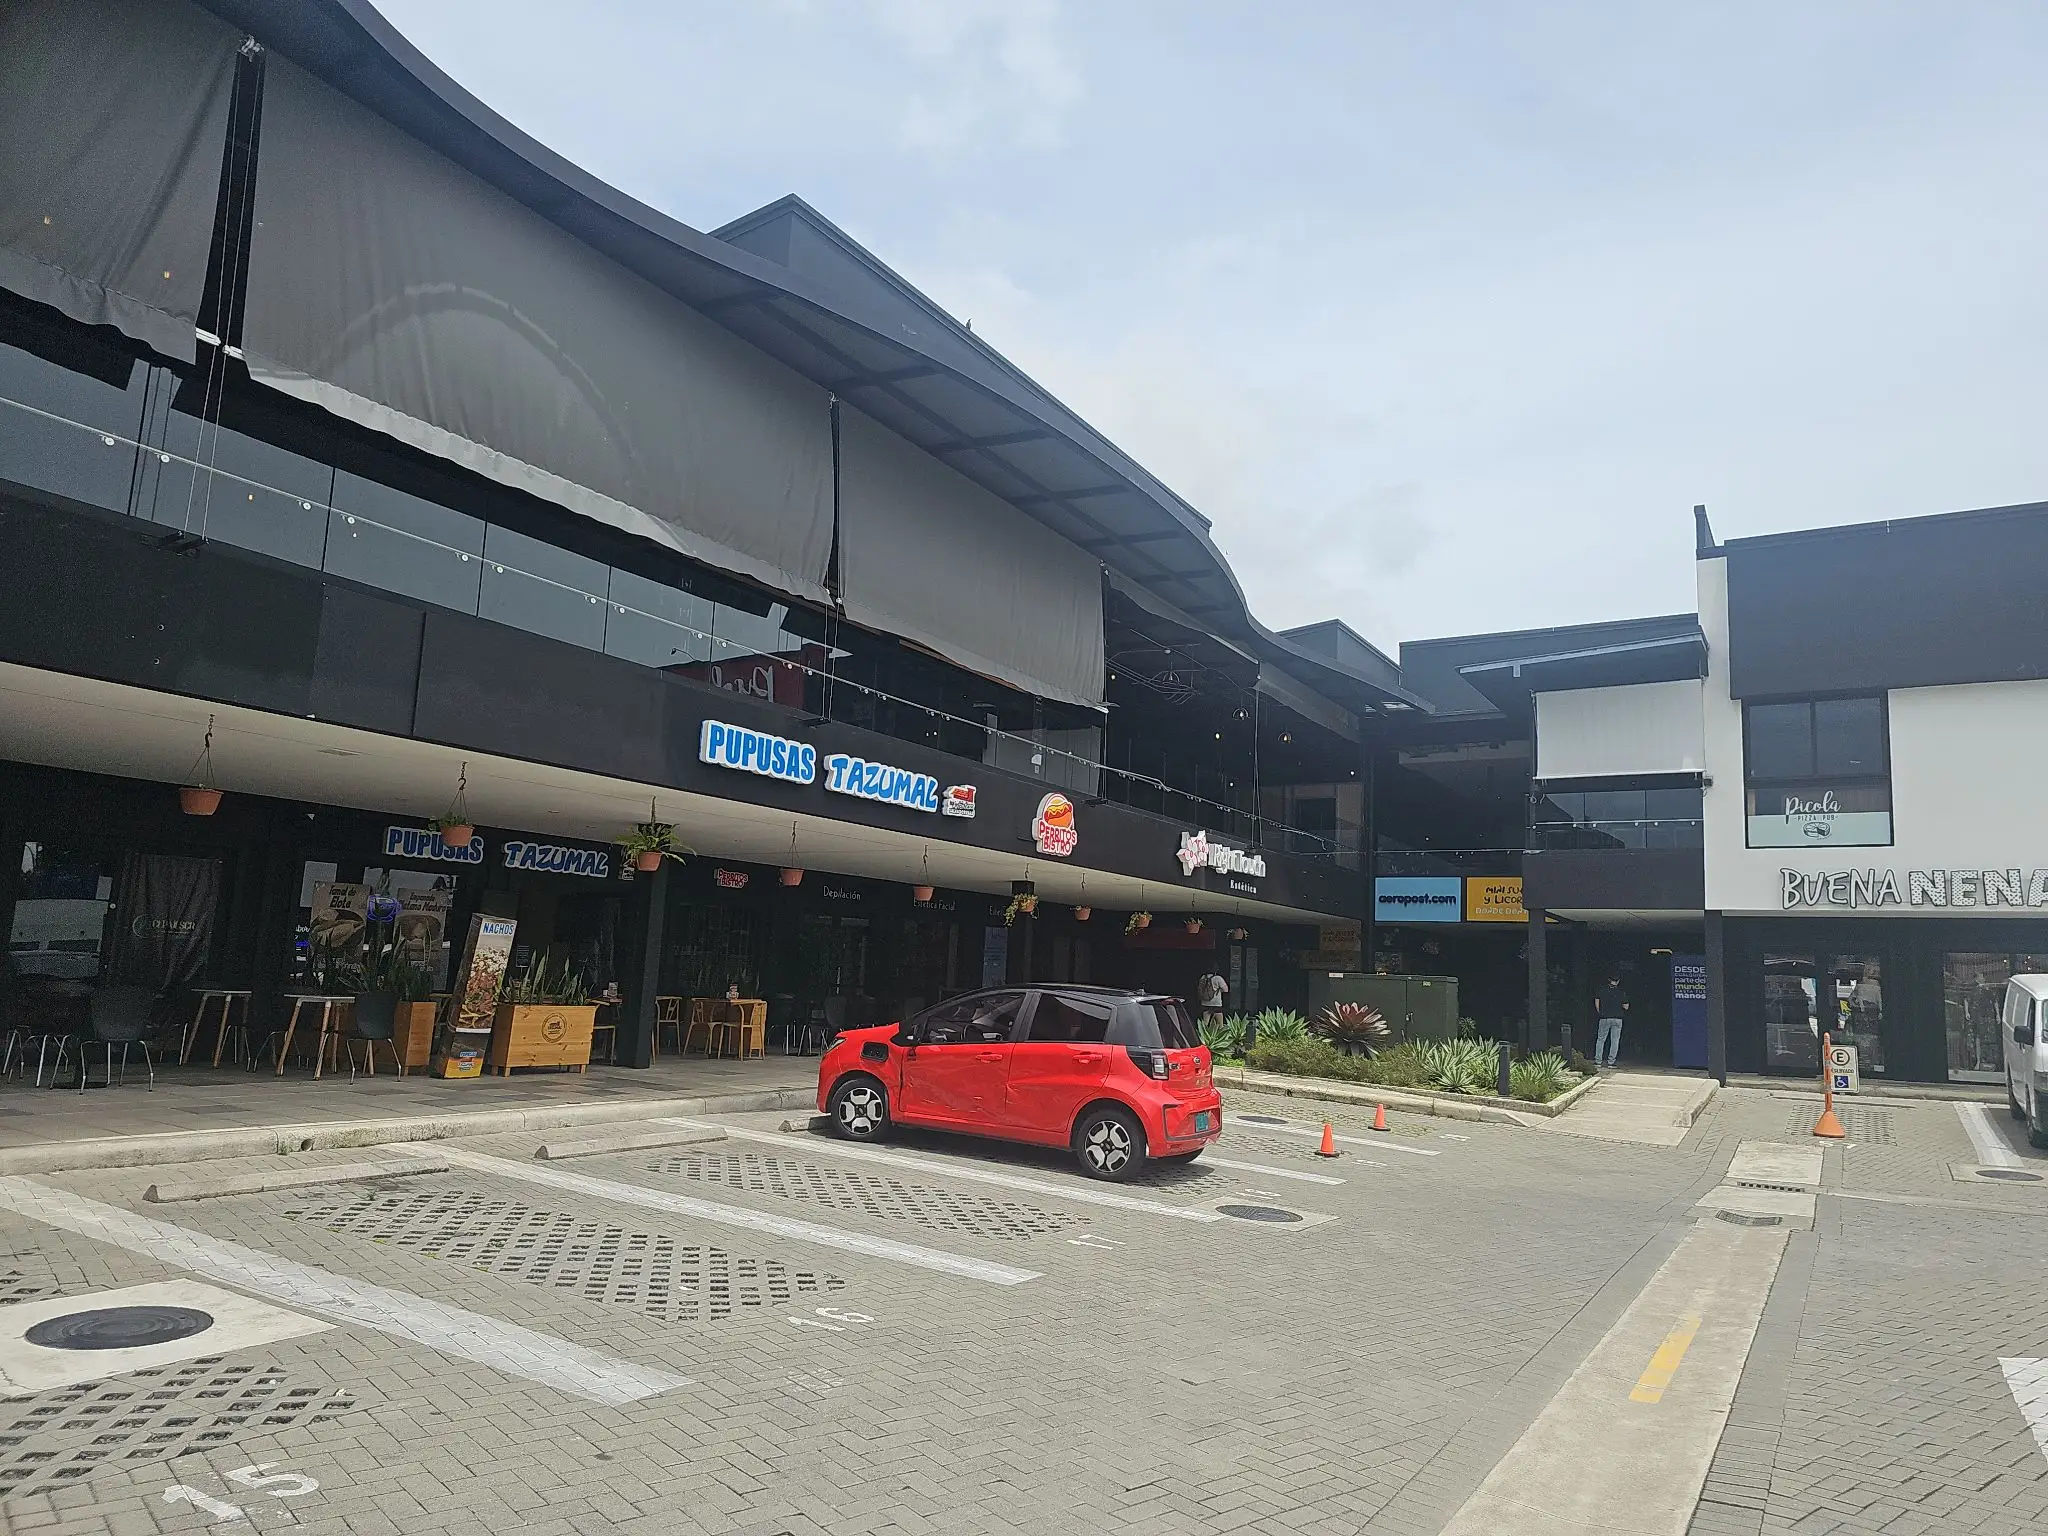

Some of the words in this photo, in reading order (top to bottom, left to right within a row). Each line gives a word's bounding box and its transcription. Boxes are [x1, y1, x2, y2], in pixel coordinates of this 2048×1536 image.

[703, 721, 816, 784] PUPUSAS
[828, 754, 939, 813] TAZUMAL
[1785, 790, 1841, 824] Picola
[1039, 820, 1077, 845] PERRITOS
[1044, 836, 1072, 853] BISTRO
[504, 842, 609, 878] TAZUMAL
[823, 886, 861, 900] Depilación
[1230, 880, 1257, 894] Estética
[1485, 885, 1505, 894] MINI
[1780, 868, 1902, 909] BUENA
[1908, 869, 2048, 907] NENA
[1378, 893, 1457, 907] aeropost.com
[482, 922, 515, 935] NACHOS
[1836, 1052, 1844, 1062] E
[1066, 1234, 1127, 1250] 17
[787, 1307, 875, 1331] 16
[161, 1461, 320, 1521] 15
